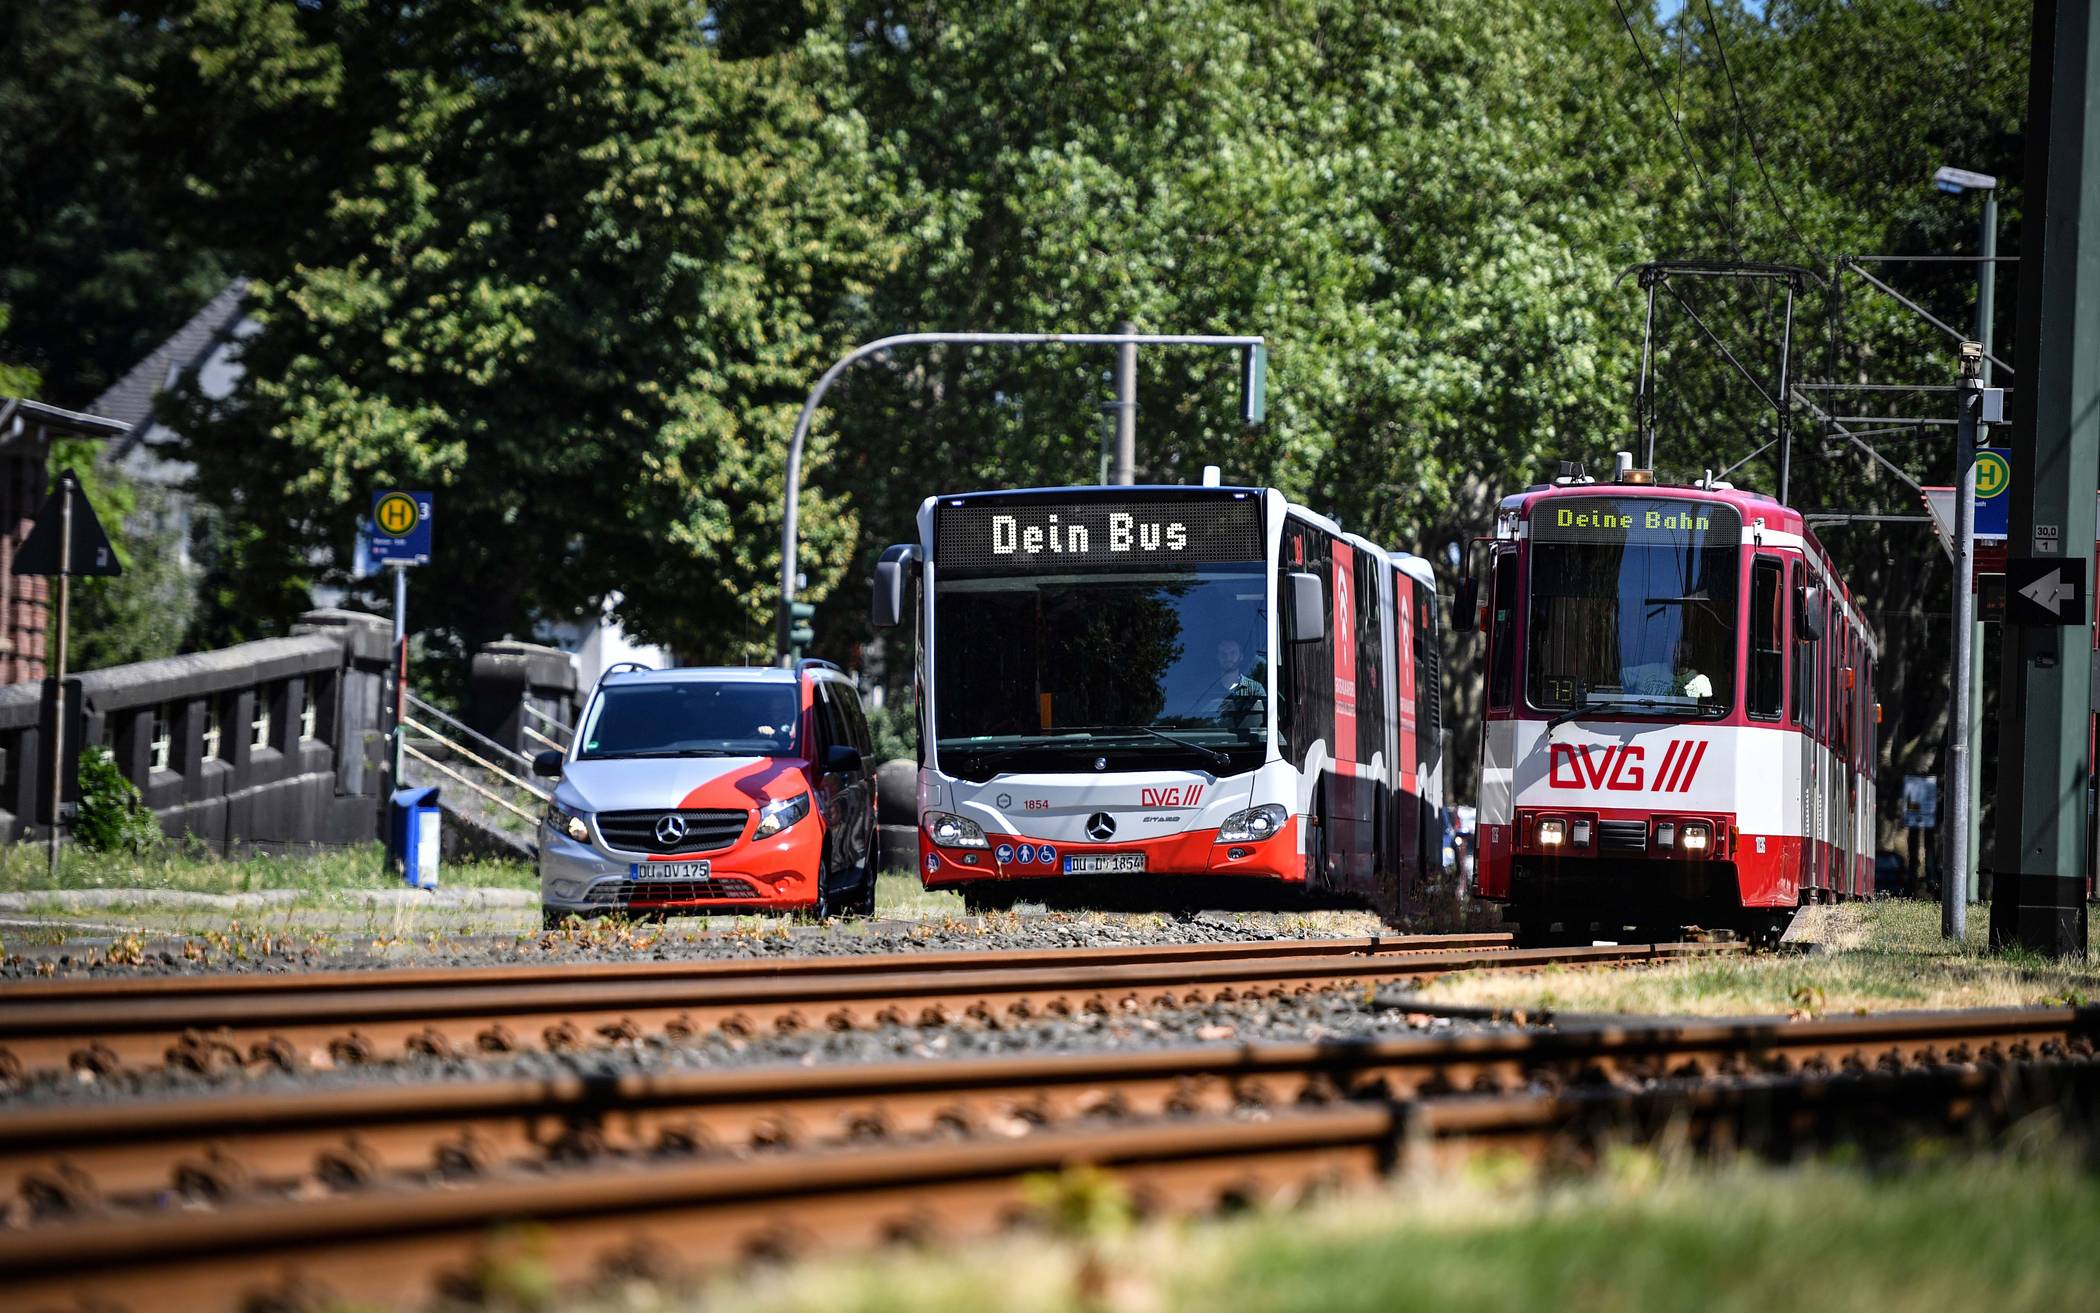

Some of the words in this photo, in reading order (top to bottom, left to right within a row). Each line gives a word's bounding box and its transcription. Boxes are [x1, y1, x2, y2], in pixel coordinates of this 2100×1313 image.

[1975, 464, 1996, 485] H
[388, 503, 406, 526] H
[419, 502, 431, 520] 3
[1557, 509, 1633, 528] Deine
[1645, 511, 1709, 530] Bahn
[993, 514, 1089, 554] Dein
[1110, 512, 1187, 552] Bus
[2037, 527, 2057, 536] 30,0
[2042, 542, 2049, 551] 1
[1549, 743, 1645, 791] DVG
[1023, 800, 1049, 810] 1854
[639, 865, 655, 878] DU
[664, 864, 680, 877] DV
[683, 863, 707, 877] 175
[1072, 857, 1087, 871] DU
[1113, 856, 1140, 870] 1854
